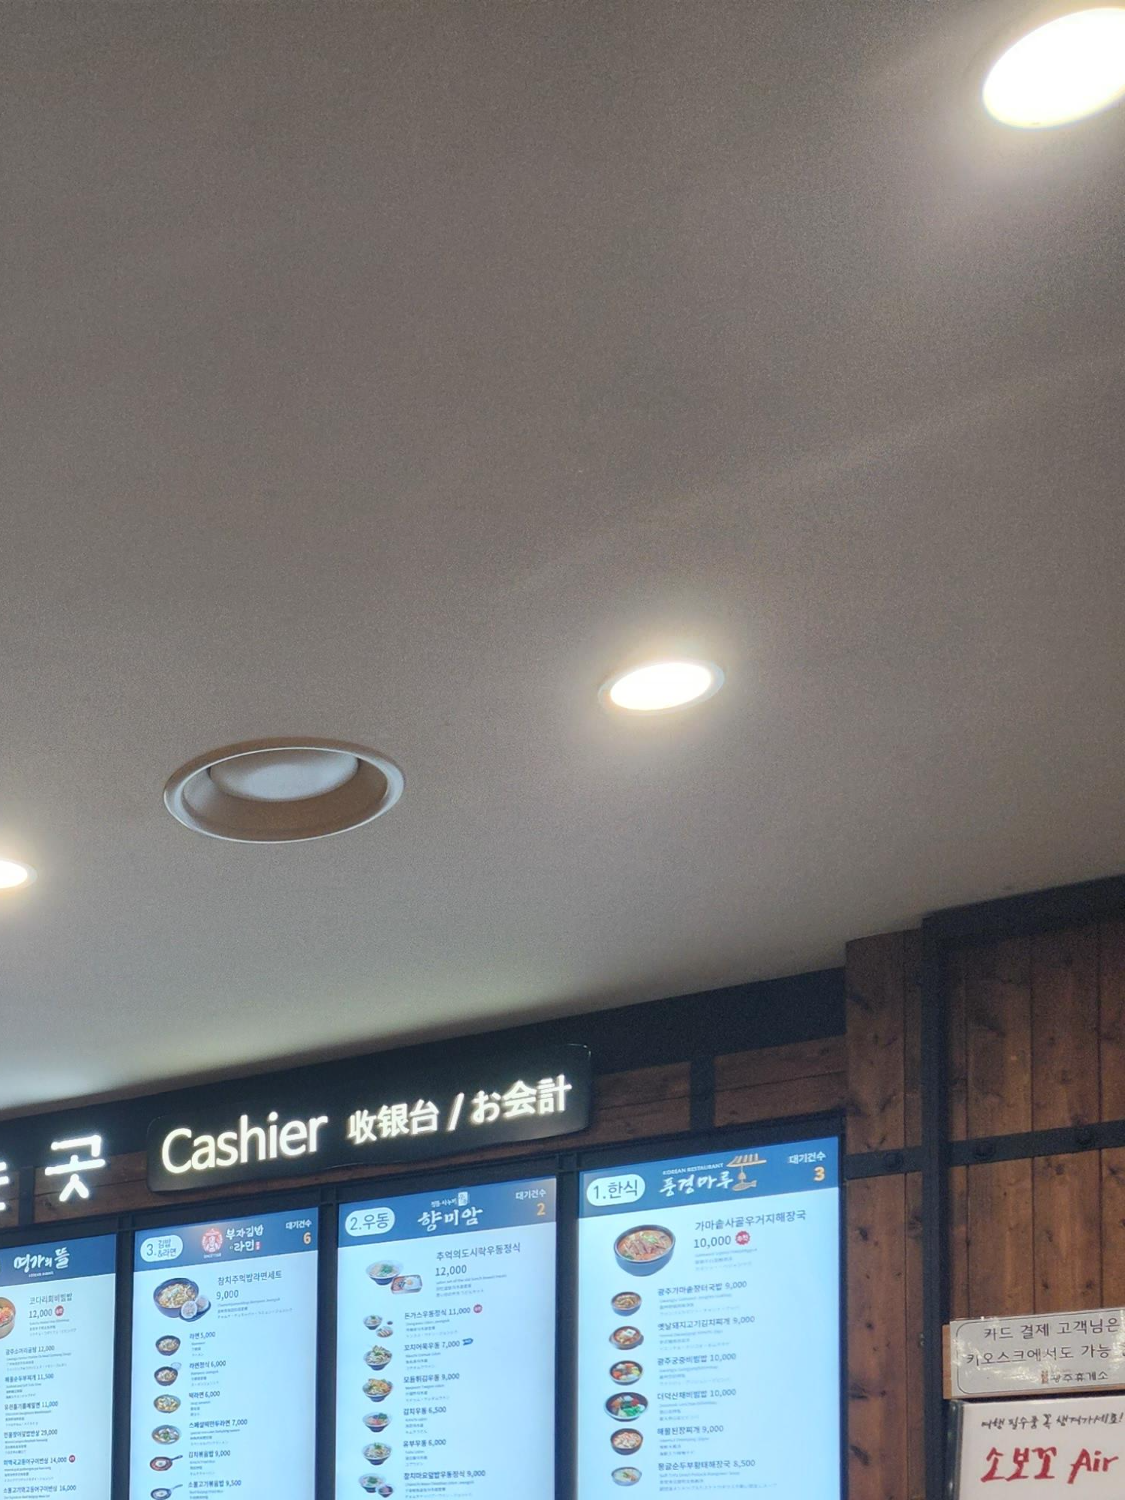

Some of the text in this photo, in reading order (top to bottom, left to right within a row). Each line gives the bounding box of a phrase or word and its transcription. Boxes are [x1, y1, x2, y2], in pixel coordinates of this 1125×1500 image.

[161, 1074, 573, 1174] Cashier 收银台 / お会計
[788, 1151, 826, 1165] 대기건수
[45, 1134, 106, 1202] 곳
[813, 1166, 825, 1182] 3
[592, 1179, 639, 1200] 1.한식
[659, 1170, 734, 1196] 풍경마루
[515, 1188, 546, 1201] 대기건수
[536, 1202, 546, 1216] 2
[285, 1218, 312, 1230] 대기건수
[350, 1211, 390, 1231] 2.우동
[417, 1206, 483, 1232] 향미암
[694, 1209, 807, 1232] 가마솥사골우거지해장국
[225, 1224, 264, 1241] 부자김밥
[303, 1231, 312, 1245] 6
[693, 1235, 732, 1250] 10,000
[435, 1242, 521, 1261] 추억의도시락우동정식
[434, 1264, 467, 1278] 12,000
[217, 1270, 282, 1286] 참치주먹밥라면세트
[215, 1289, 239, 1301] 9,000
[657, 1280, 747, 1297] 광주가마솥장터국밥 9,000
[29, 1292, 73, 1306] 코다리회비빔밥
[28, 1308, 53, 1319] 12,000
[404, 1306, 471, 1320] 돈가스우동정식 11,000
[657, 1315, 755, 1332] 옛날돼지고기김치찌개 9,000
[983, 1317, 1121, 1342] 카드 결제 고객님은
[189, 1331, 216, 1340] 라면 5,000
[37, 1345, 55, 1353] 12,000
[441, 1340, 461, 1349] 7,000
[657, 1353, 737, 1366] 광주궁중비빔밥 10,000
[966, 1344, 1112, 1367] 키오스크에서도 가능
[188, 1360, 227, 1370] 라면정식 6,000
[37, 1373, 54, 1381] 11,500
[403, 1372, 460, 1384] 모듬튀김우동 9,000
[204, 1390, 221, 1398] 6,000
[657, 1388, 737, 1401] 더덕산채비빔밥 10,000
[41, 1400, 59, 1408] 11,000
[403, 1405, 447, 1416] 김치우동 6,500
[231, 1418, 248, 1426] 7,000
[980, 1417, 1006, 1430] 여행
[657, 1424, 724, 1437] 해물된장찌개 9,000
[403, 1438, 447, 1448] 유부우동 6,000
[188, 1449, 231, 1459] 김치볶음밥 9,000
[733, 1458, 756, 1468] 8,500
[1067, 1448, 1120, 1485] Air
[403, 1469, 486, 1481] 참치마요덮밥우동정식 9,000
[188, 1479, 242, 1488] 소불고기볶음밥 9,500
